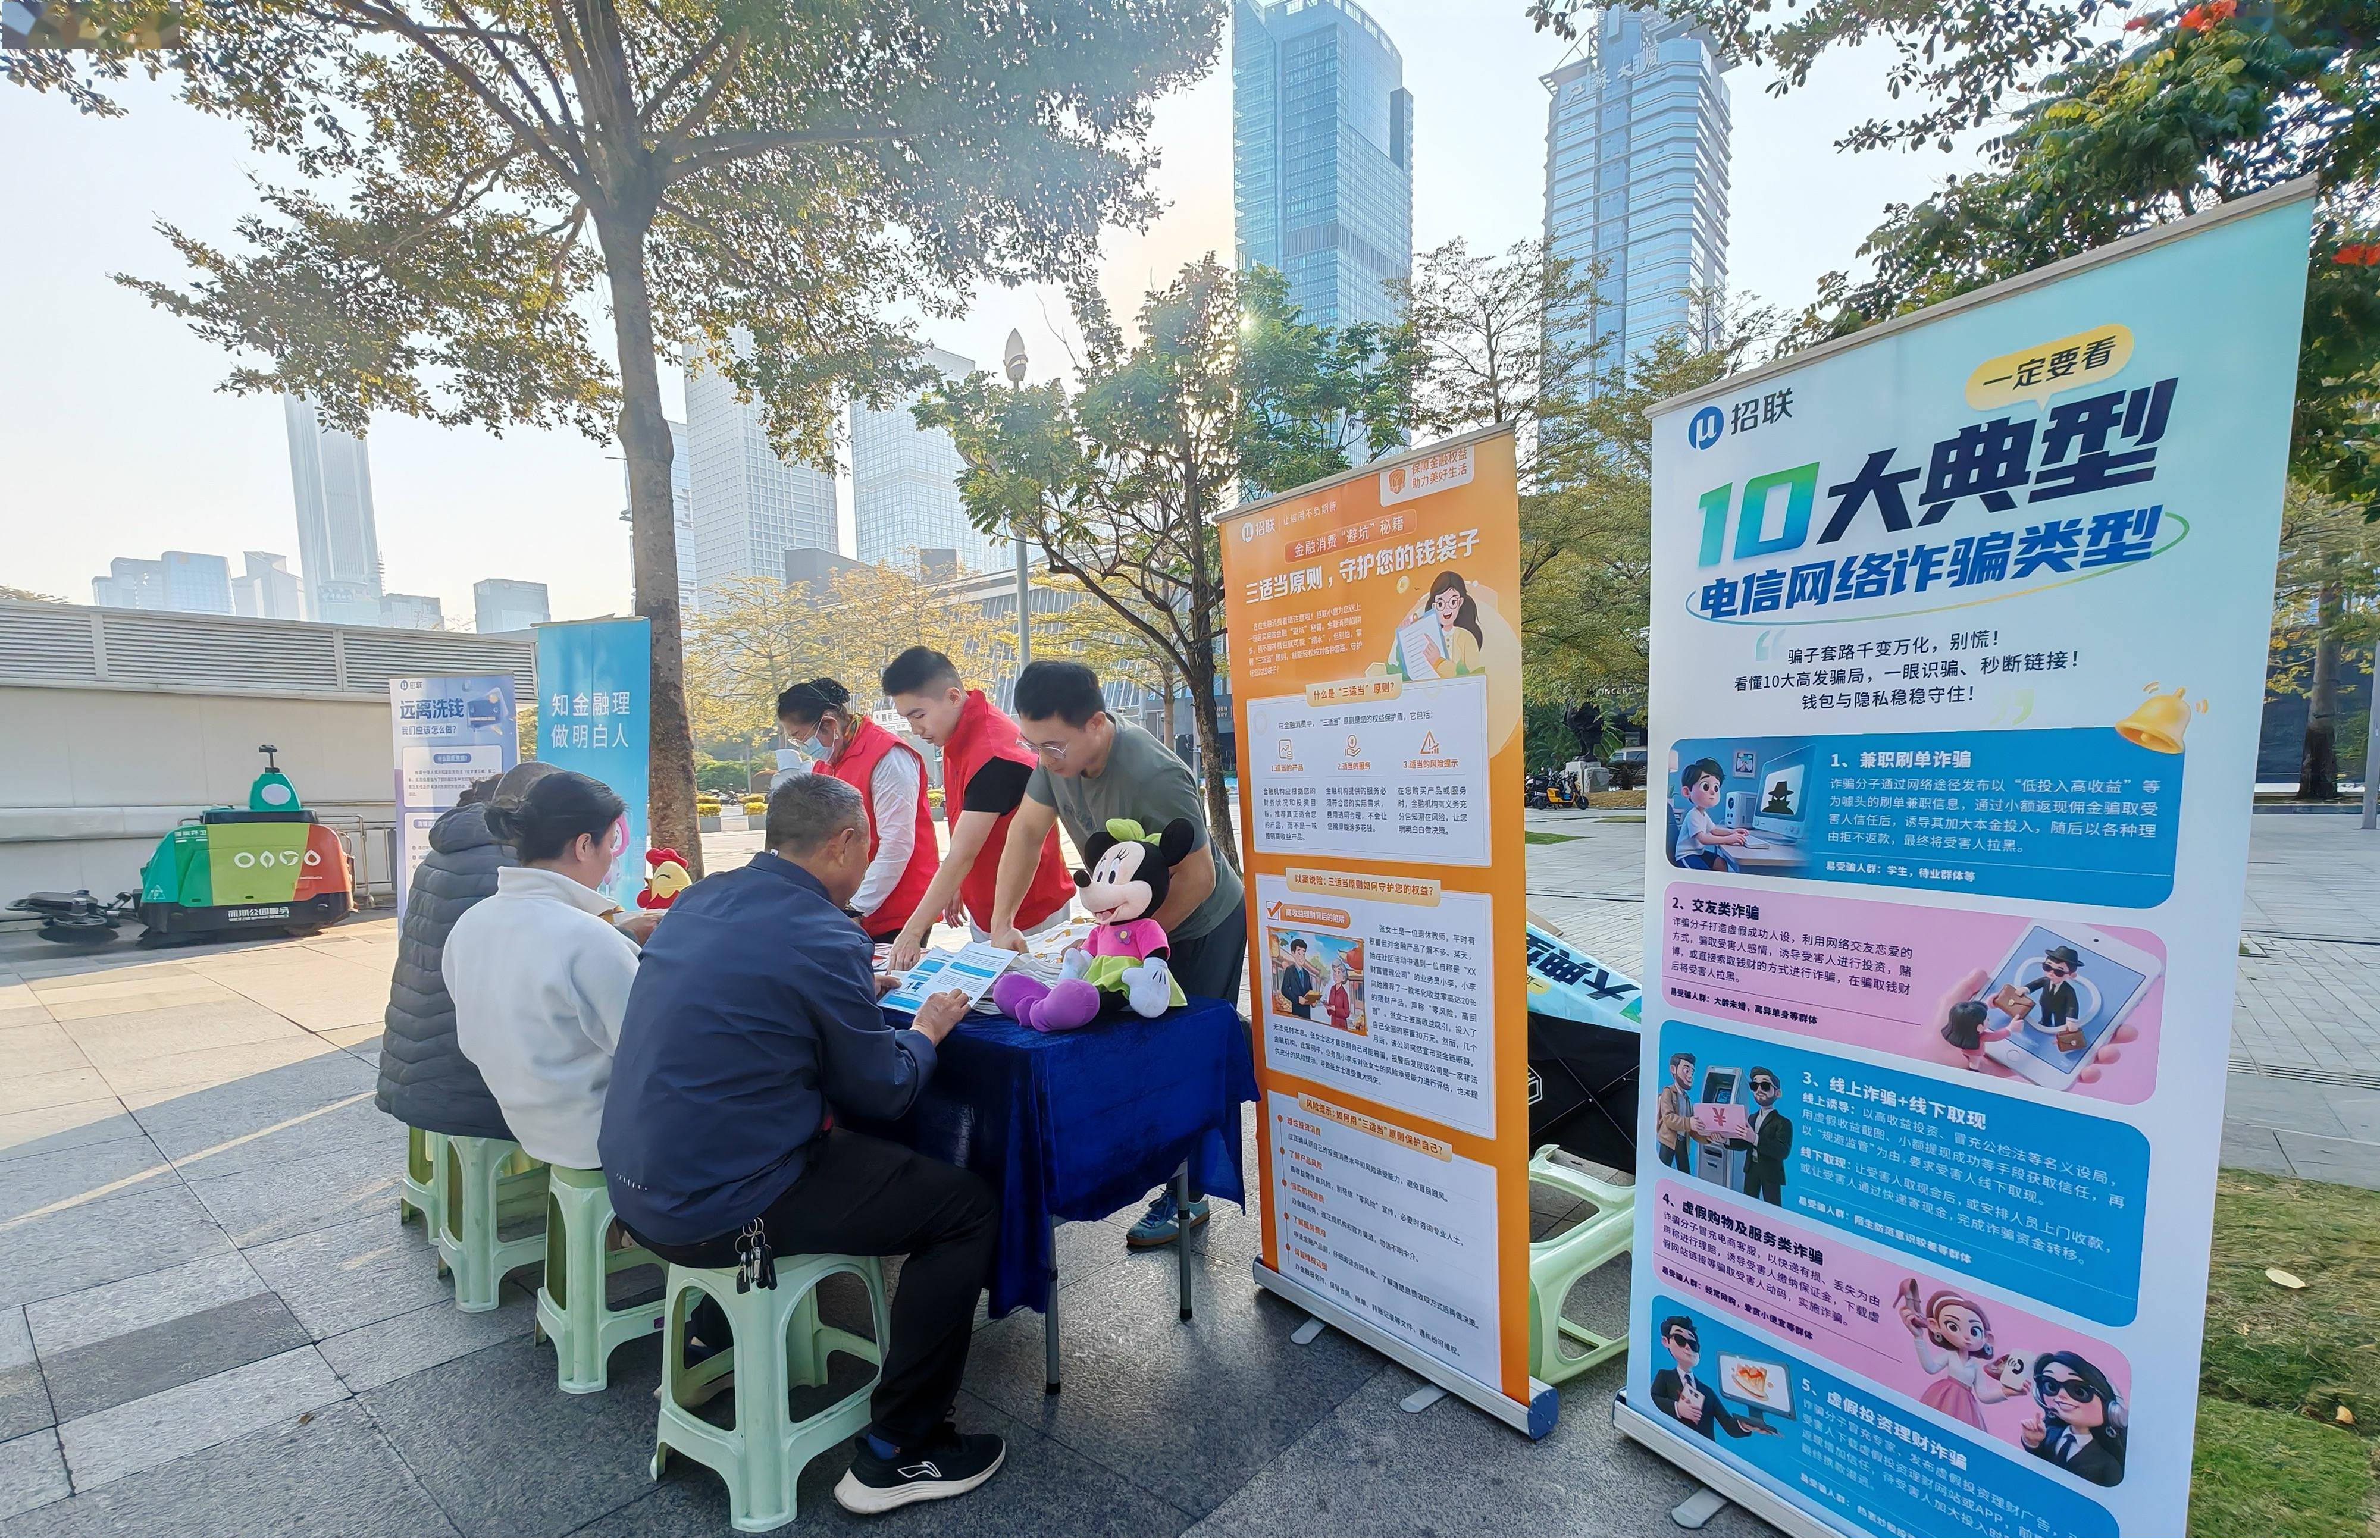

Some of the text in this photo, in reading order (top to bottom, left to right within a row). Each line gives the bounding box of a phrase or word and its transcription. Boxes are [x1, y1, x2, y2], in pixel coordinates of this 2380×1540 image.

[1983, 336, 2115, 390] 一定要看
[1731, 388, 1793, 435] 招联
[1412, 447, 1467, 475] 保障金融权益
[1412, 463, 1467, 489] 助力美好生活
[1699, 378, 2179, 567] 10大典型
[1255, 518, 1275, 537] 招联
[1294, 516, 1404, 557] 金融消费“避坑”秘籍
[1245, 528, 1480, 605] 三适当原则，守护您的钱袋子
[1699, 506, 2163, 618] 电信网络诈骗类型
[1788, 630, 2000, 665] 骗子套路千变万化，别慌！
[1734, 650, 2080, 692] 看懂10大高发骗局，一眼识骗、秒断链接！
[552, 692, 630, 717] 知金融理
[1313, 683, 1394, 700] 什么是“三适当”原则？
[1802, 685, 1976, 710] 钱包与隐私稳稳守住！
[400, 698, 464, 719] 远离洗钱
[551, 723, 629, 749] 做明白人
[1830, 751, 1971, 769] 1、兼职刷单诈骗
[1398, 786, 1467, 795] 在您购买产品或服务
[1830, 778, 2160, 793] 诈骗分子通过网络途径发布以“低投入高收益”等
[1830, 796, 2158, 817] 为噱头的刷单兼职信息，通过小额返现佣金骗取受
[1829, 814, 2156, 838] 害人信任后，诱导其加大本金投入，随后以各种理
[1828, 832, 2023, 853] 由拒不返款，最终将受害人拉黑。
[1672, 898, 1759, 920] 2、交友类诈骗
[1673, 917, 1913, 959] 诈骗分子打造虚假成功人设，利用网络交友恋爱的
[1673, 933, 1912, 977] 方式，骗取受害人感情，诱导受害人进行投资，赌
[1671, 961, 1740, 983] 后将受害人拉黑。
[1672, 947, 1911, 995] 博，或直接索取钱财的方式进行诈骗，在骗取钱财
[1802, 1072, 1986, 1130] 3、线上诈骗+线下取现
[1662, 1194, 1823, 1266] 4、虚假购物及服务类诈骗
[1802, 1379, 1966, 1471] 5、虚假投资理财诈骗
[1802, 1429, 2010, 1538] 返现增加信任，待受害人加大投入时
[1803, 1398, 2077, 1538] 诈骗分子冒充专家、发布虚假投资理财广告，
